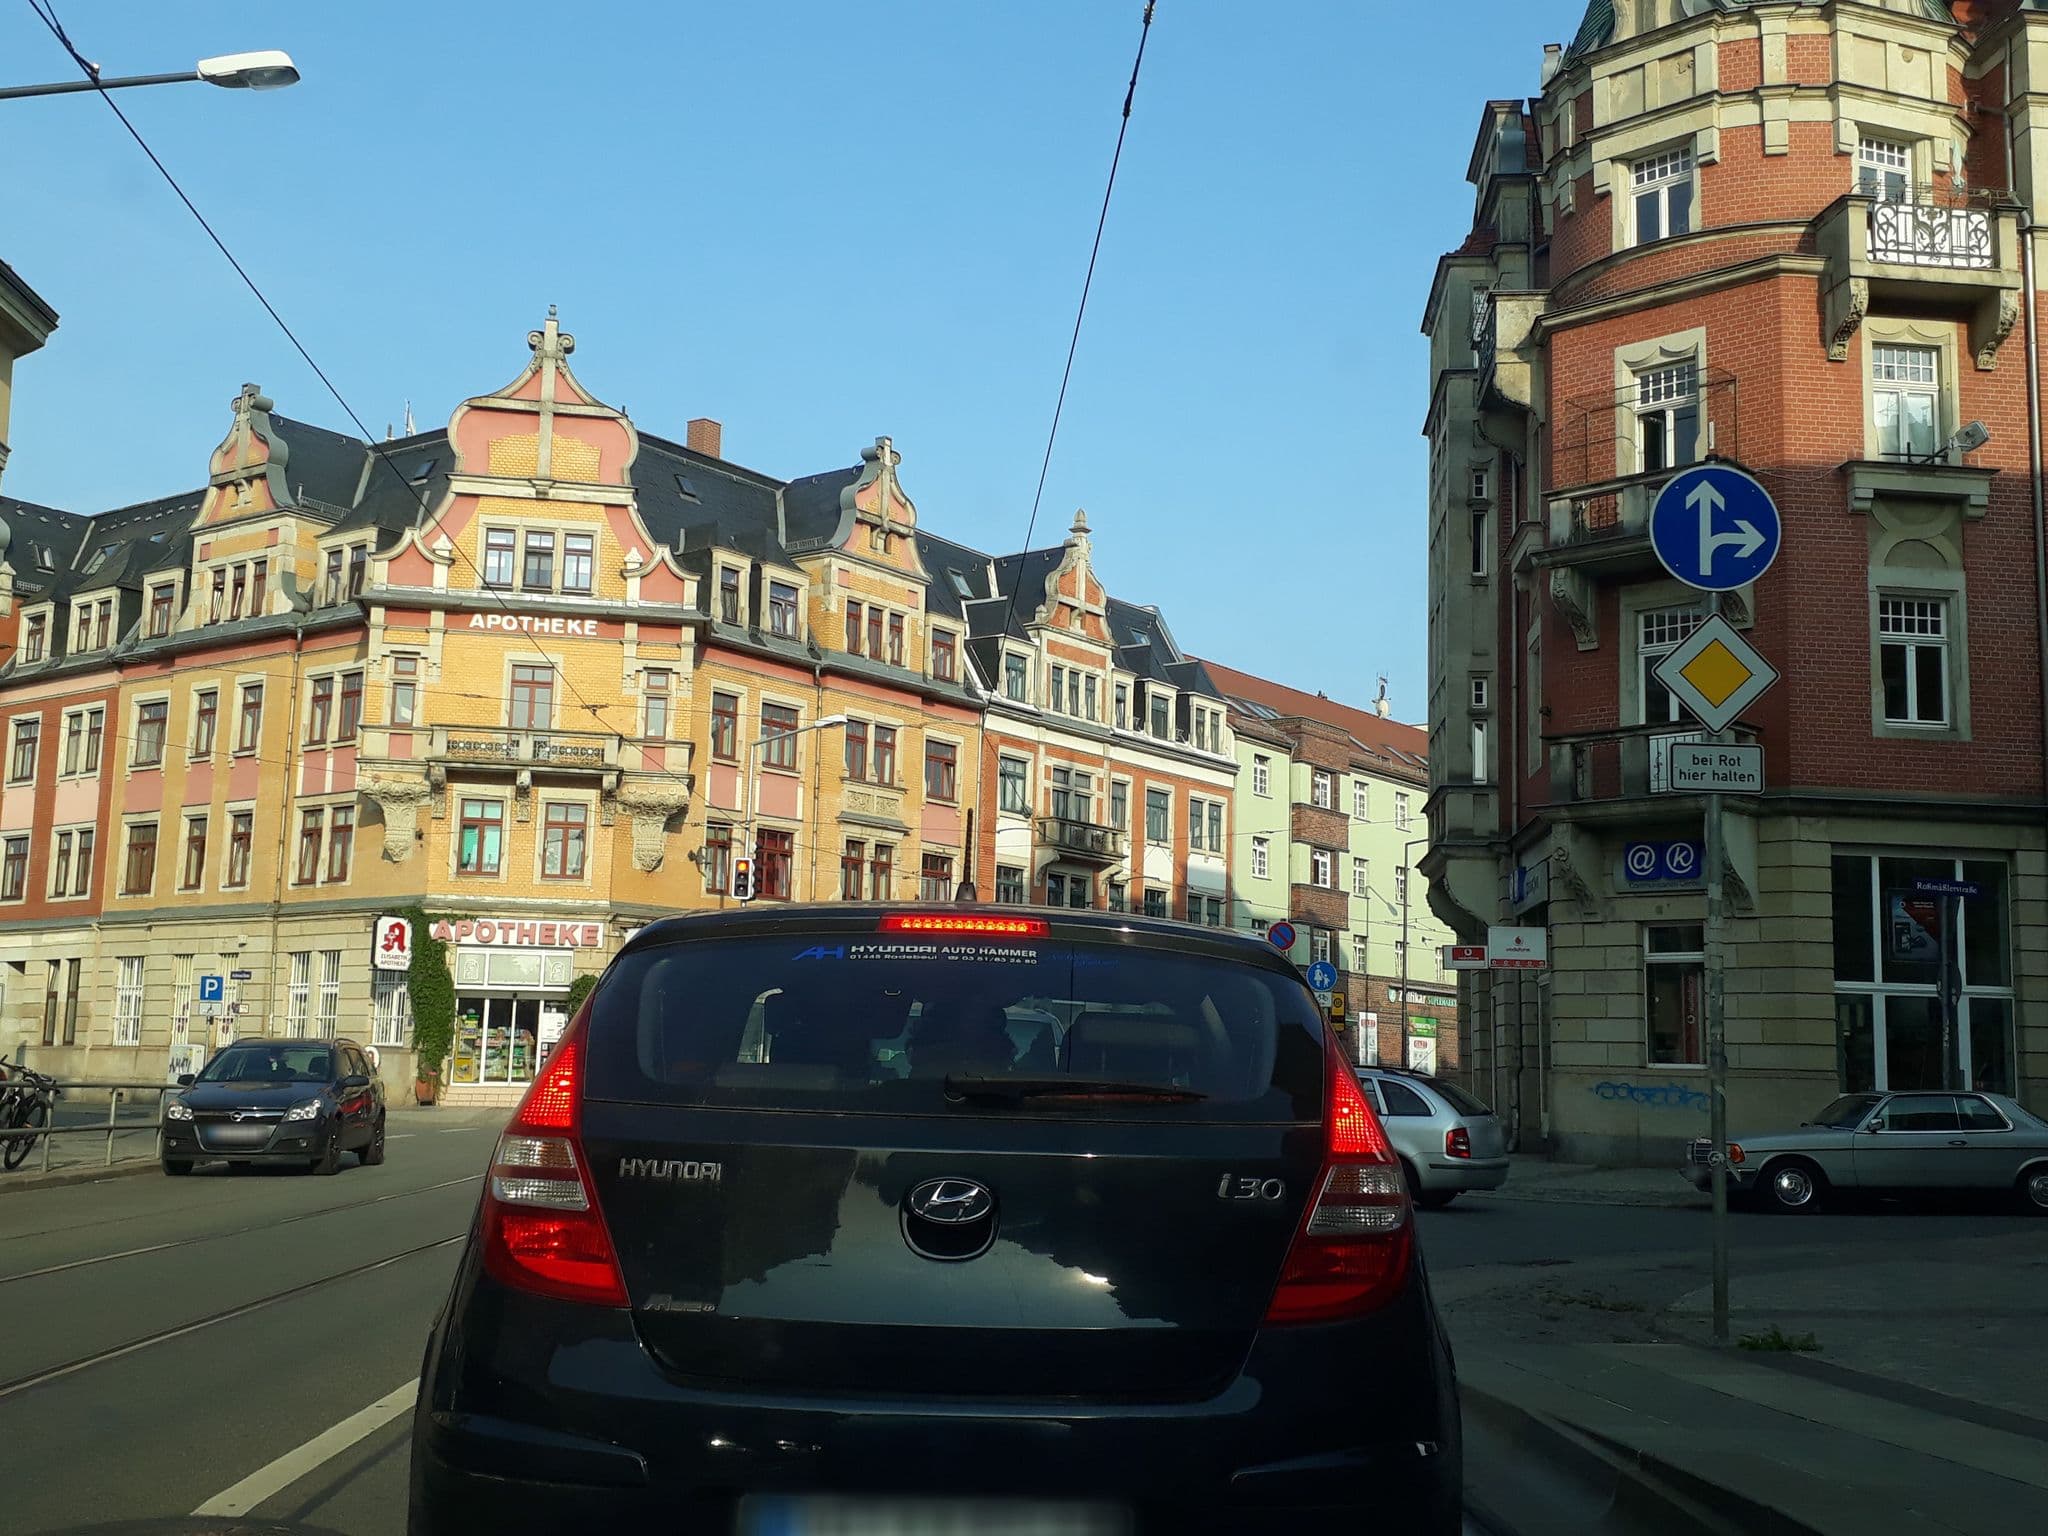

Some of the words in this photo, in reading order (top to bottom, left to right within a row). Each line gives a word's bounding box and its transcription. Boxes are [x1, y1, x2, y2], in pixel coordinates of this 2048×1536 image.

[469, 613, 598, 636] APOTHEKE
[1692, 754, 1713, 766] bei
[1719, 754, 1741, 767] Rot
[1679, 769, 1706, 781] hier
[1712, 769, 1755, 783] halten
[431, 918, 599, 947] APOTHEKE
[850, 945, 937, 954] HYUNDAI
[941, 946, 976, 954] AUTO
[979, 947, 1038, 958] HAMMER
[205, 979, 218, 998] P
[618, 1157, 722, 1181] HYUNDAI
[1217, 1173, 1286, 1200] i30
